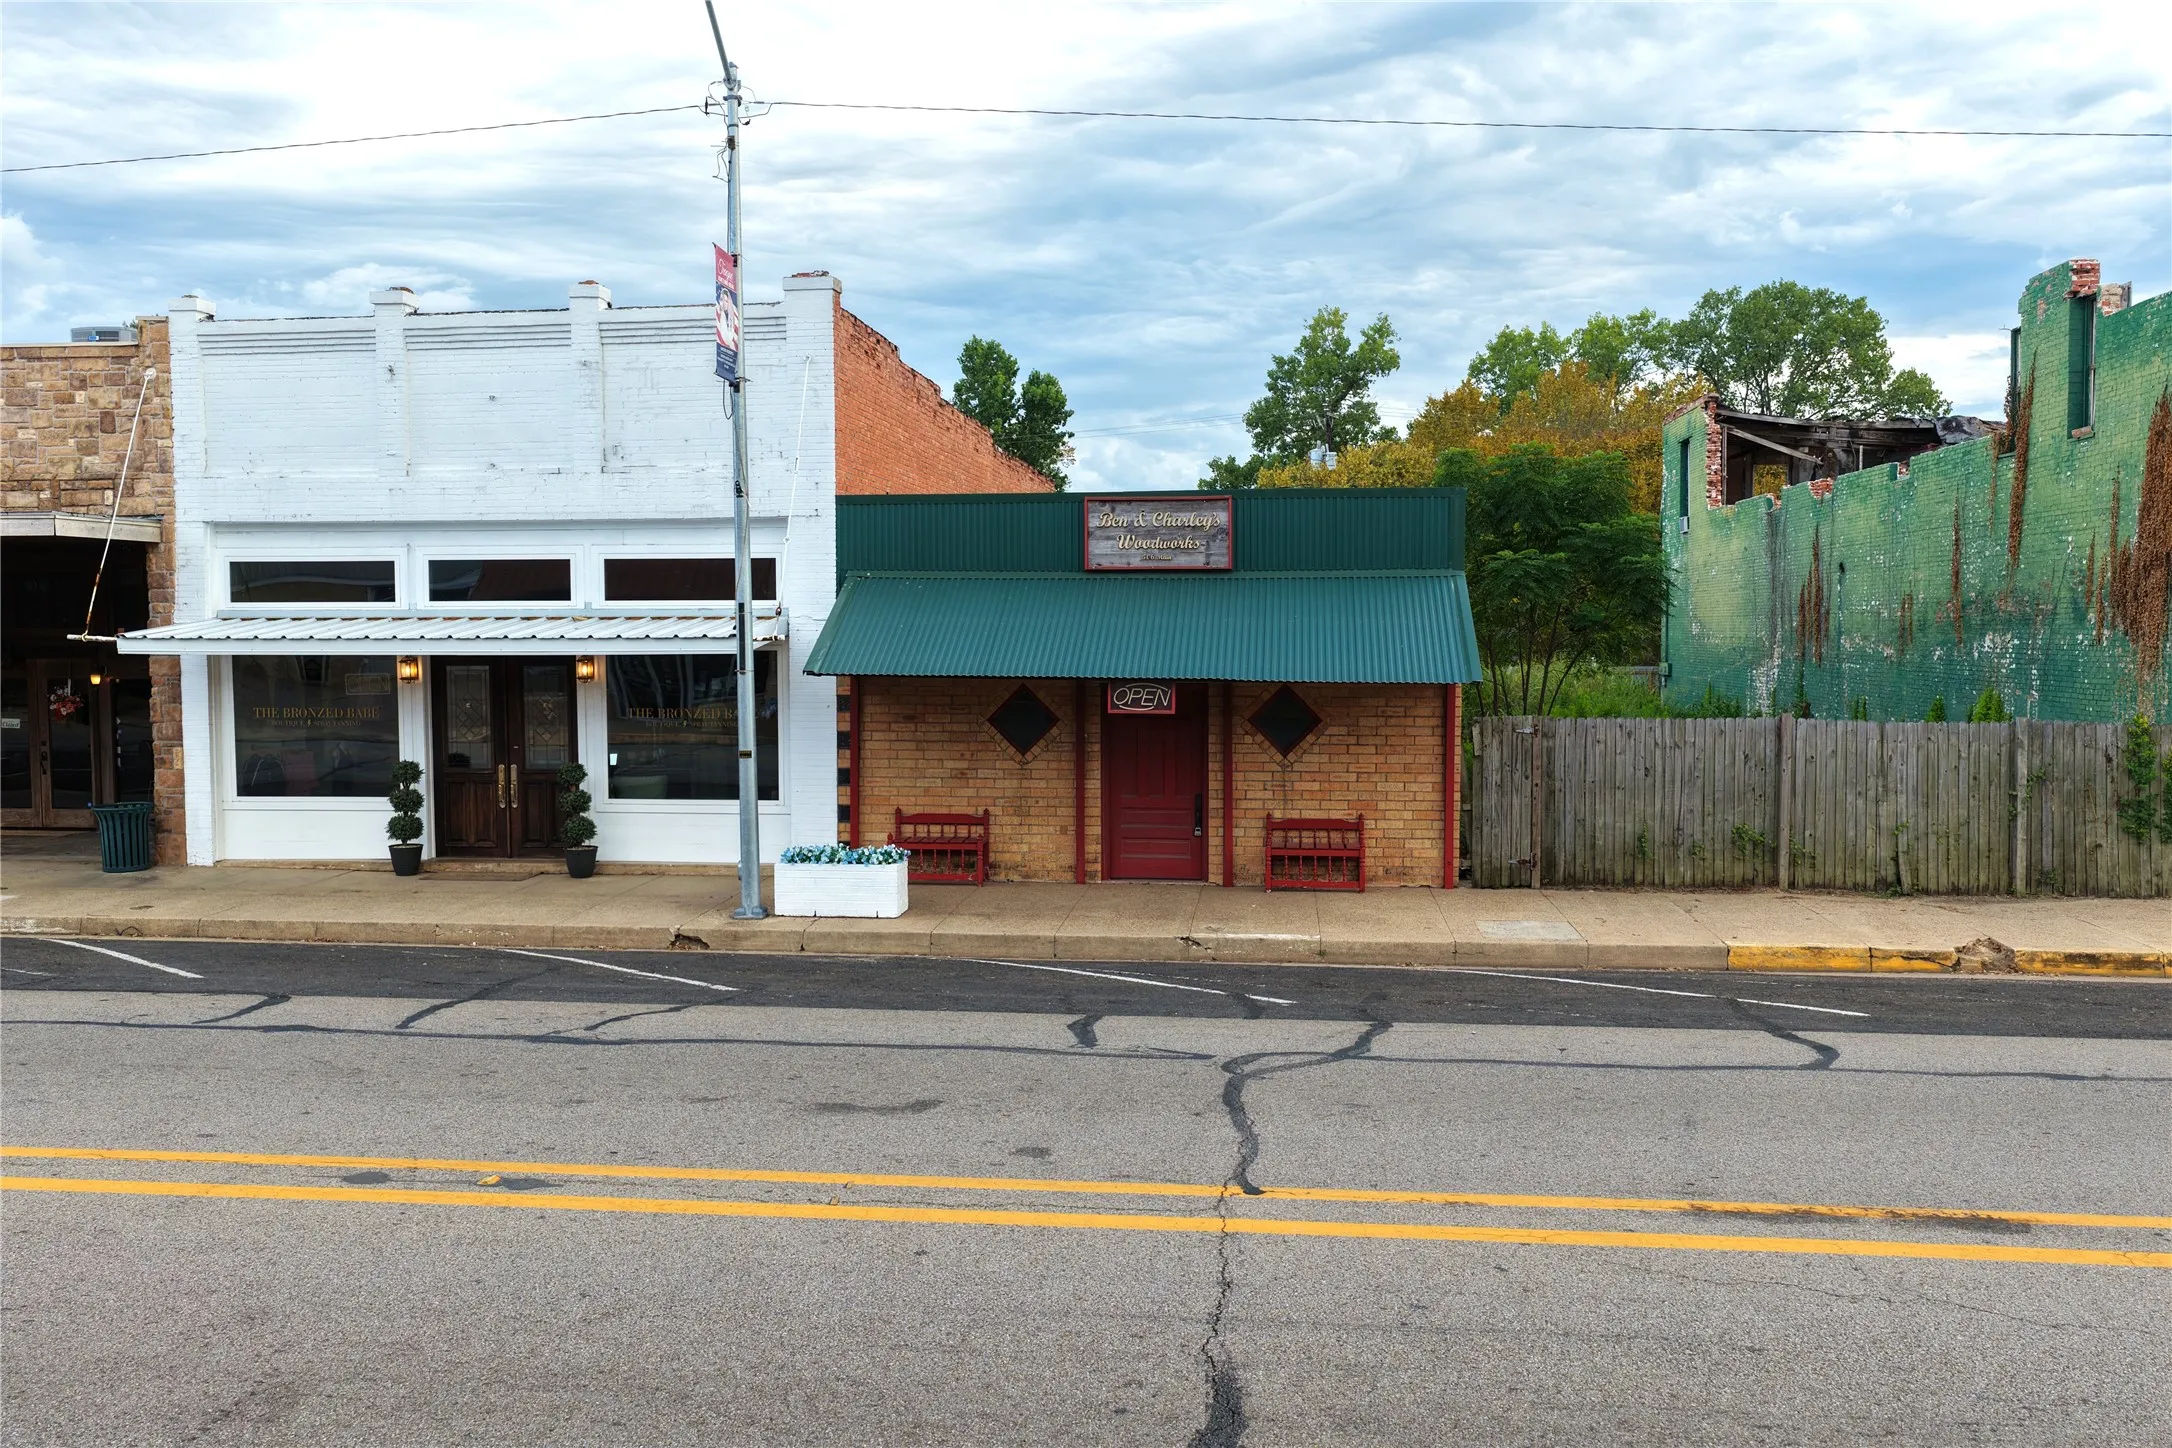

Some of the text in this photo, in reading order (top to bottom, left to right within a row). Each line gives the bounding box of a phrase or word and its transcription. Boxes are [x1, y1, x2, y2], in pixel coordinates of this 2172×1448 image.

[1097, 511, 1221, 531] Ben & Charley's
[1116, 534, 1200, 550] Woodworks
[1113, 687, 1171, 706] OPEN
[253, 707, 380, 719] THE BRONZED BABE
[628, 707, 654, 719] THE
[658, 707, 721, 719] BRONZED
